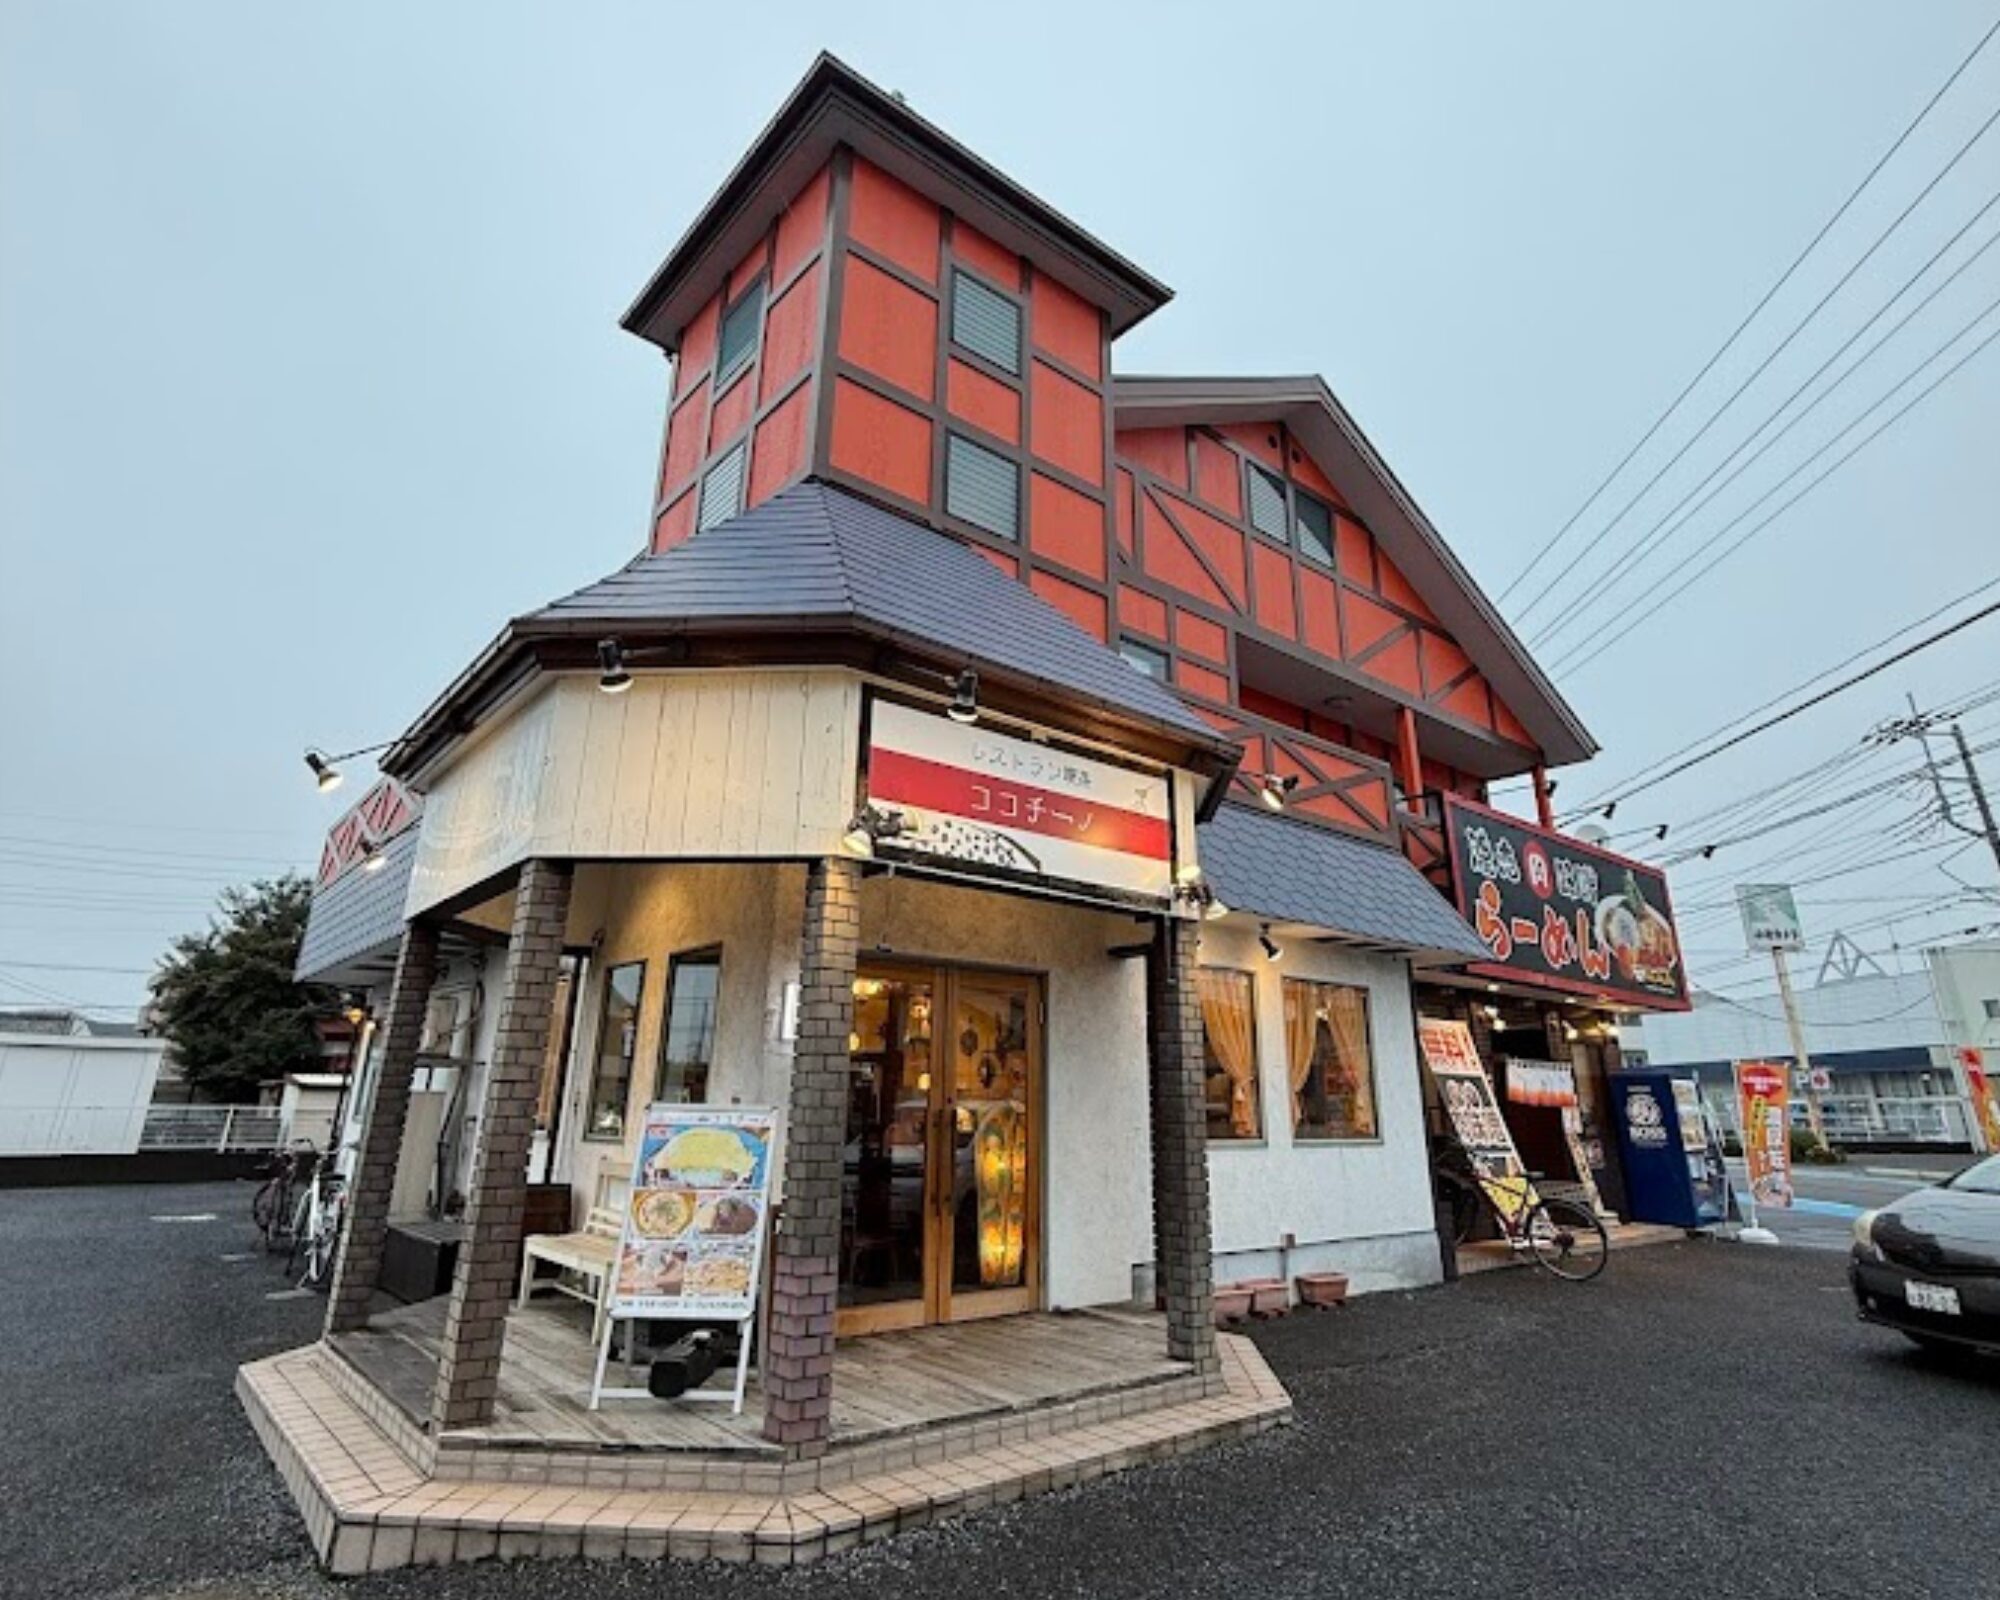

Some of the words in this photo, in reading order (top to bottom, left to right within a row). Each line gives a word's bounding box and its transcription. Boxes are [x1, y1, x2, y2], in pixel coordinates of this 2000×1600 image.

[970, 787, 1093, 831] ココチーノ
[1476, 880, 1610, 979] らーめん
